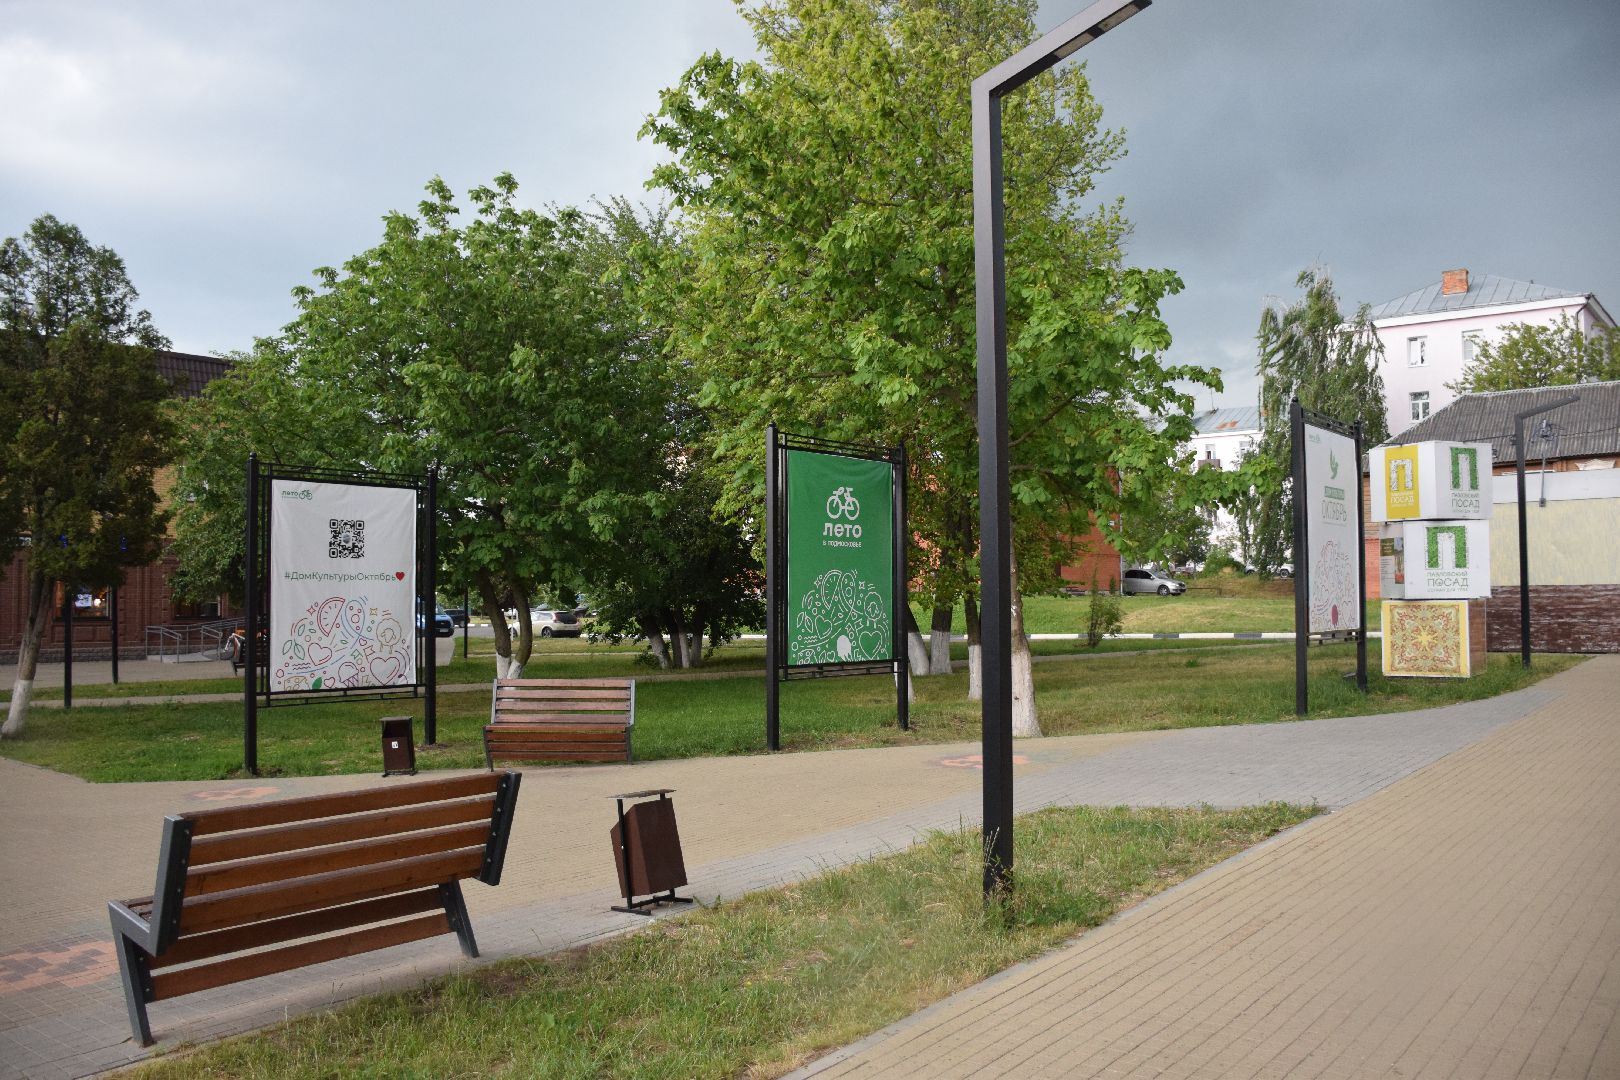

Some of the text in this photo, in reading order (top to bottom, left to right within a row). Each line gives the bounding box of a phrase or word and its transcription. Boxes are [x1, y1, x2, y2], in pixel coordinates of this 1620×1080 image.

[1451, 498, 1479, 509] ПОСАД
[823, 523, 862, 538] лето
[284, 571, 396, 583] #ДомКультурыОктябрь
[1427, 577, 1469, 587] ПОСАД
